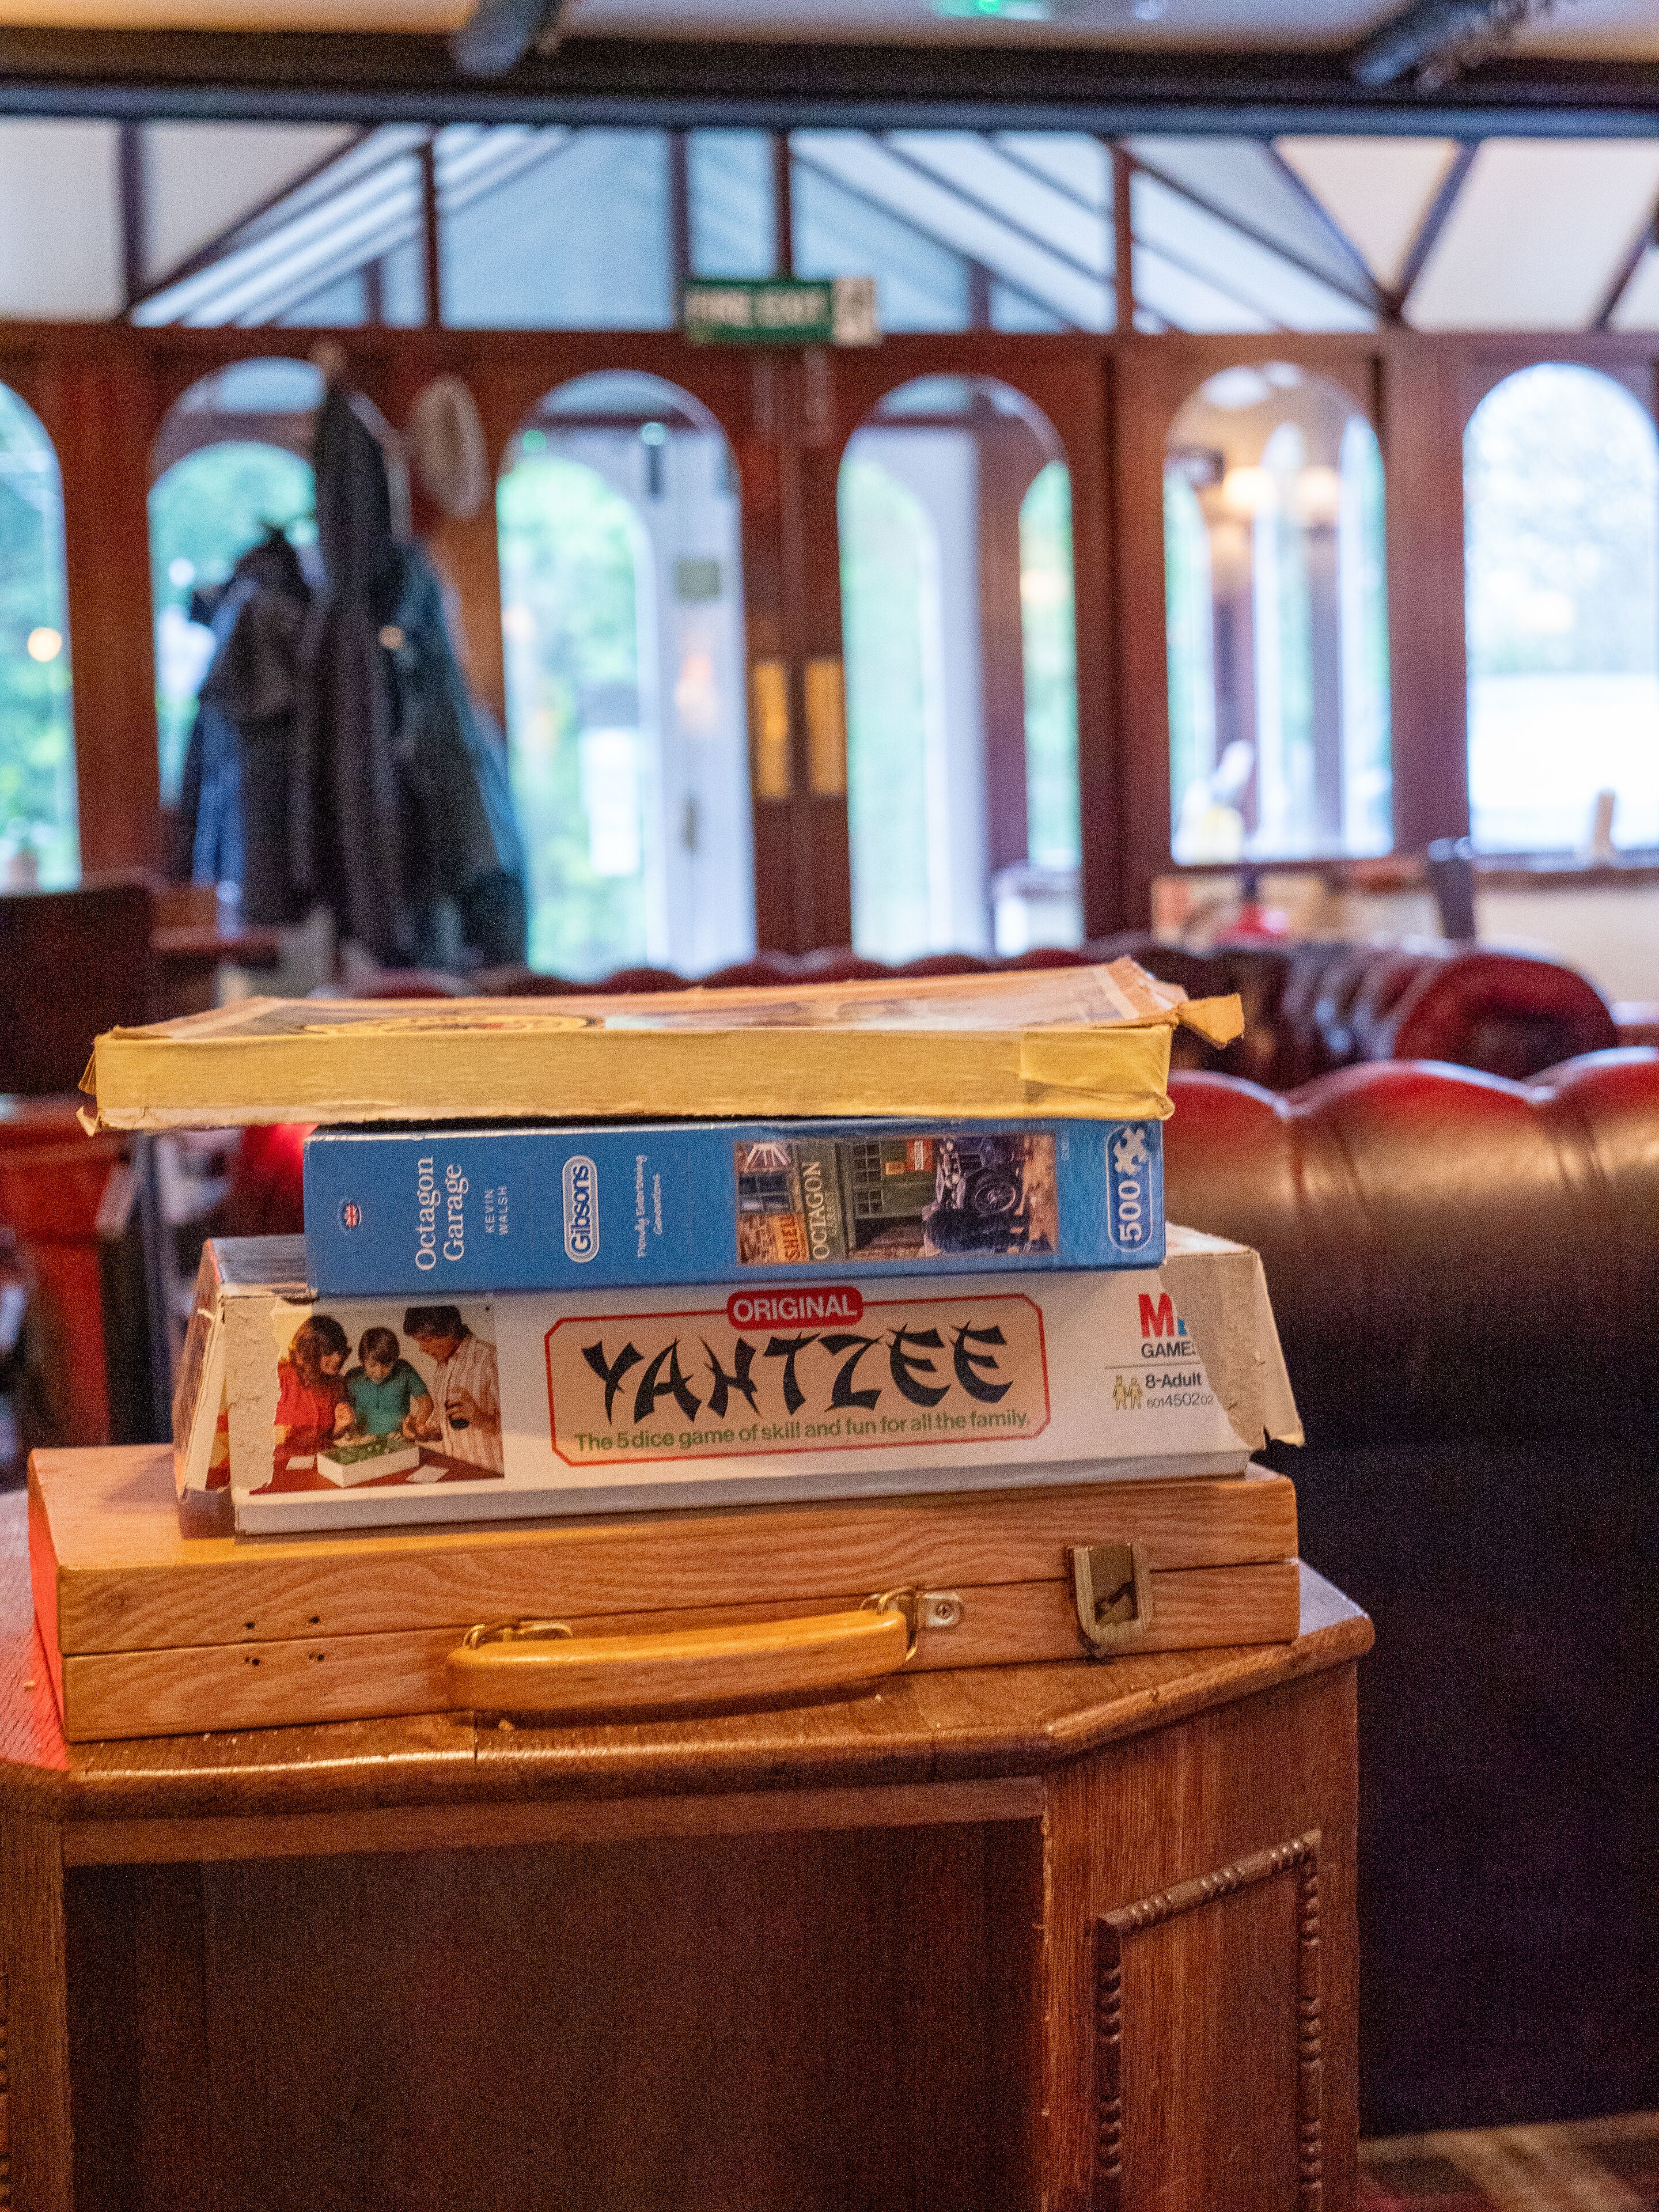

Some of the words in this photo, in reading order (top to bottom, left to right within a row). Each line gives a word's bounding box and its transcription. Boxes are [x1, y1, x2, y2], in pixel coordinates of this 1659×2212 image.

[415, 1156, 441, 1271] Octagon
[443, 1164, 469, 1262] Garage
[484, 1188, 495, 1234] KEVIN
[497, 1185, 509, 1236] WALSH
[570, 1165, 592, 1254] Gibsons
[780, 1214, 801, 1260] SHELL
[802, 1161, 830, 1260] OCTAGON
[1118, 1180, 1142, 1242] 500
[732, 1294, 857, 1324] ORIGINAL
[581, 1320, 1014, 1425] YAHTZEE
[1145, 1372, 1202, 1389] 8-Adult
[576, 1433, 612, 1452] The
[616, 1431, 629, 1450] 5
[632, 1430, 675, 1448] dice
[679, 1429, 736, 1450] game
[738, 1425, 759, 1441] of
[762, 1421, 801, 1440] skill
[804, 1419, 842, 1438] and
[845, 1418, 877, 1436] fun
[881, 1415, 908, 1433] for
[910, 1412, 933, 1431] all
[935, 1411, 967, 1430] the
